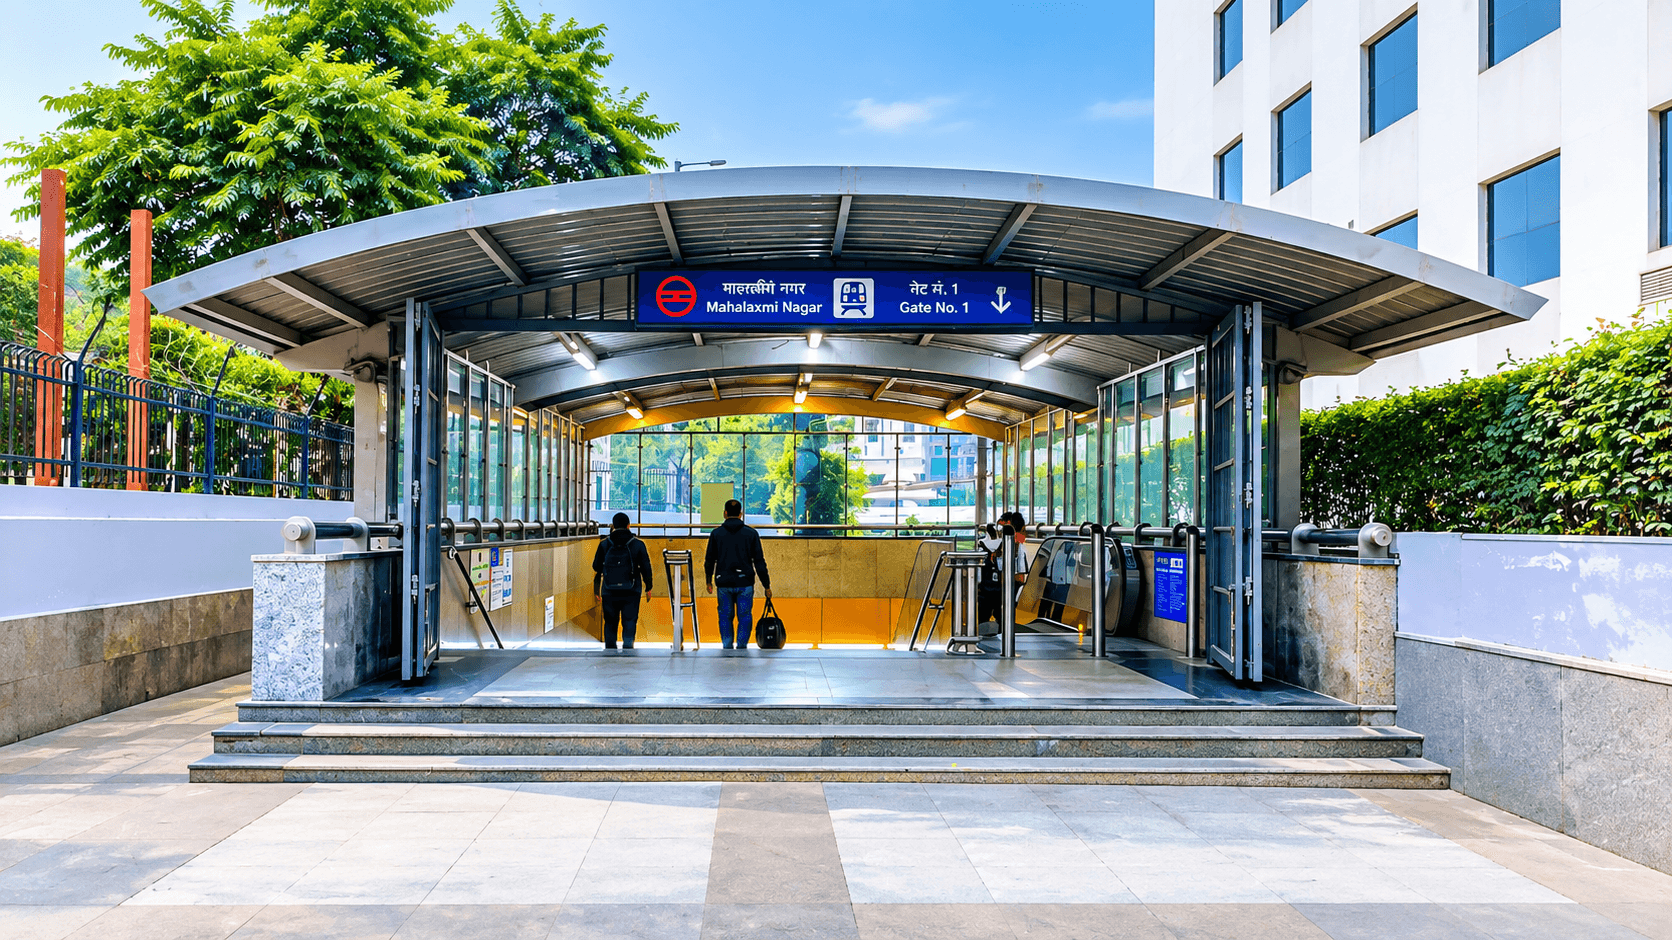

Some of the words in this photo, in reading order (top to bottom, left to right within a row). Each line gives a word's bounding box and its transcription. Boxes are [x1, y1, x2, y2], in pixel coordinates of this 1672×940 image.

[780, 282, 806, 295] नगर
[951, 283, 958, 295] 1
[706, 301, 779, 313] Mahalaxmi
[782, 301, 823, 316] Nagar
[899, 301, 932, 313] Gate
[935, 301, 958, 313] No.
[962, 302, 969, 313] 1
